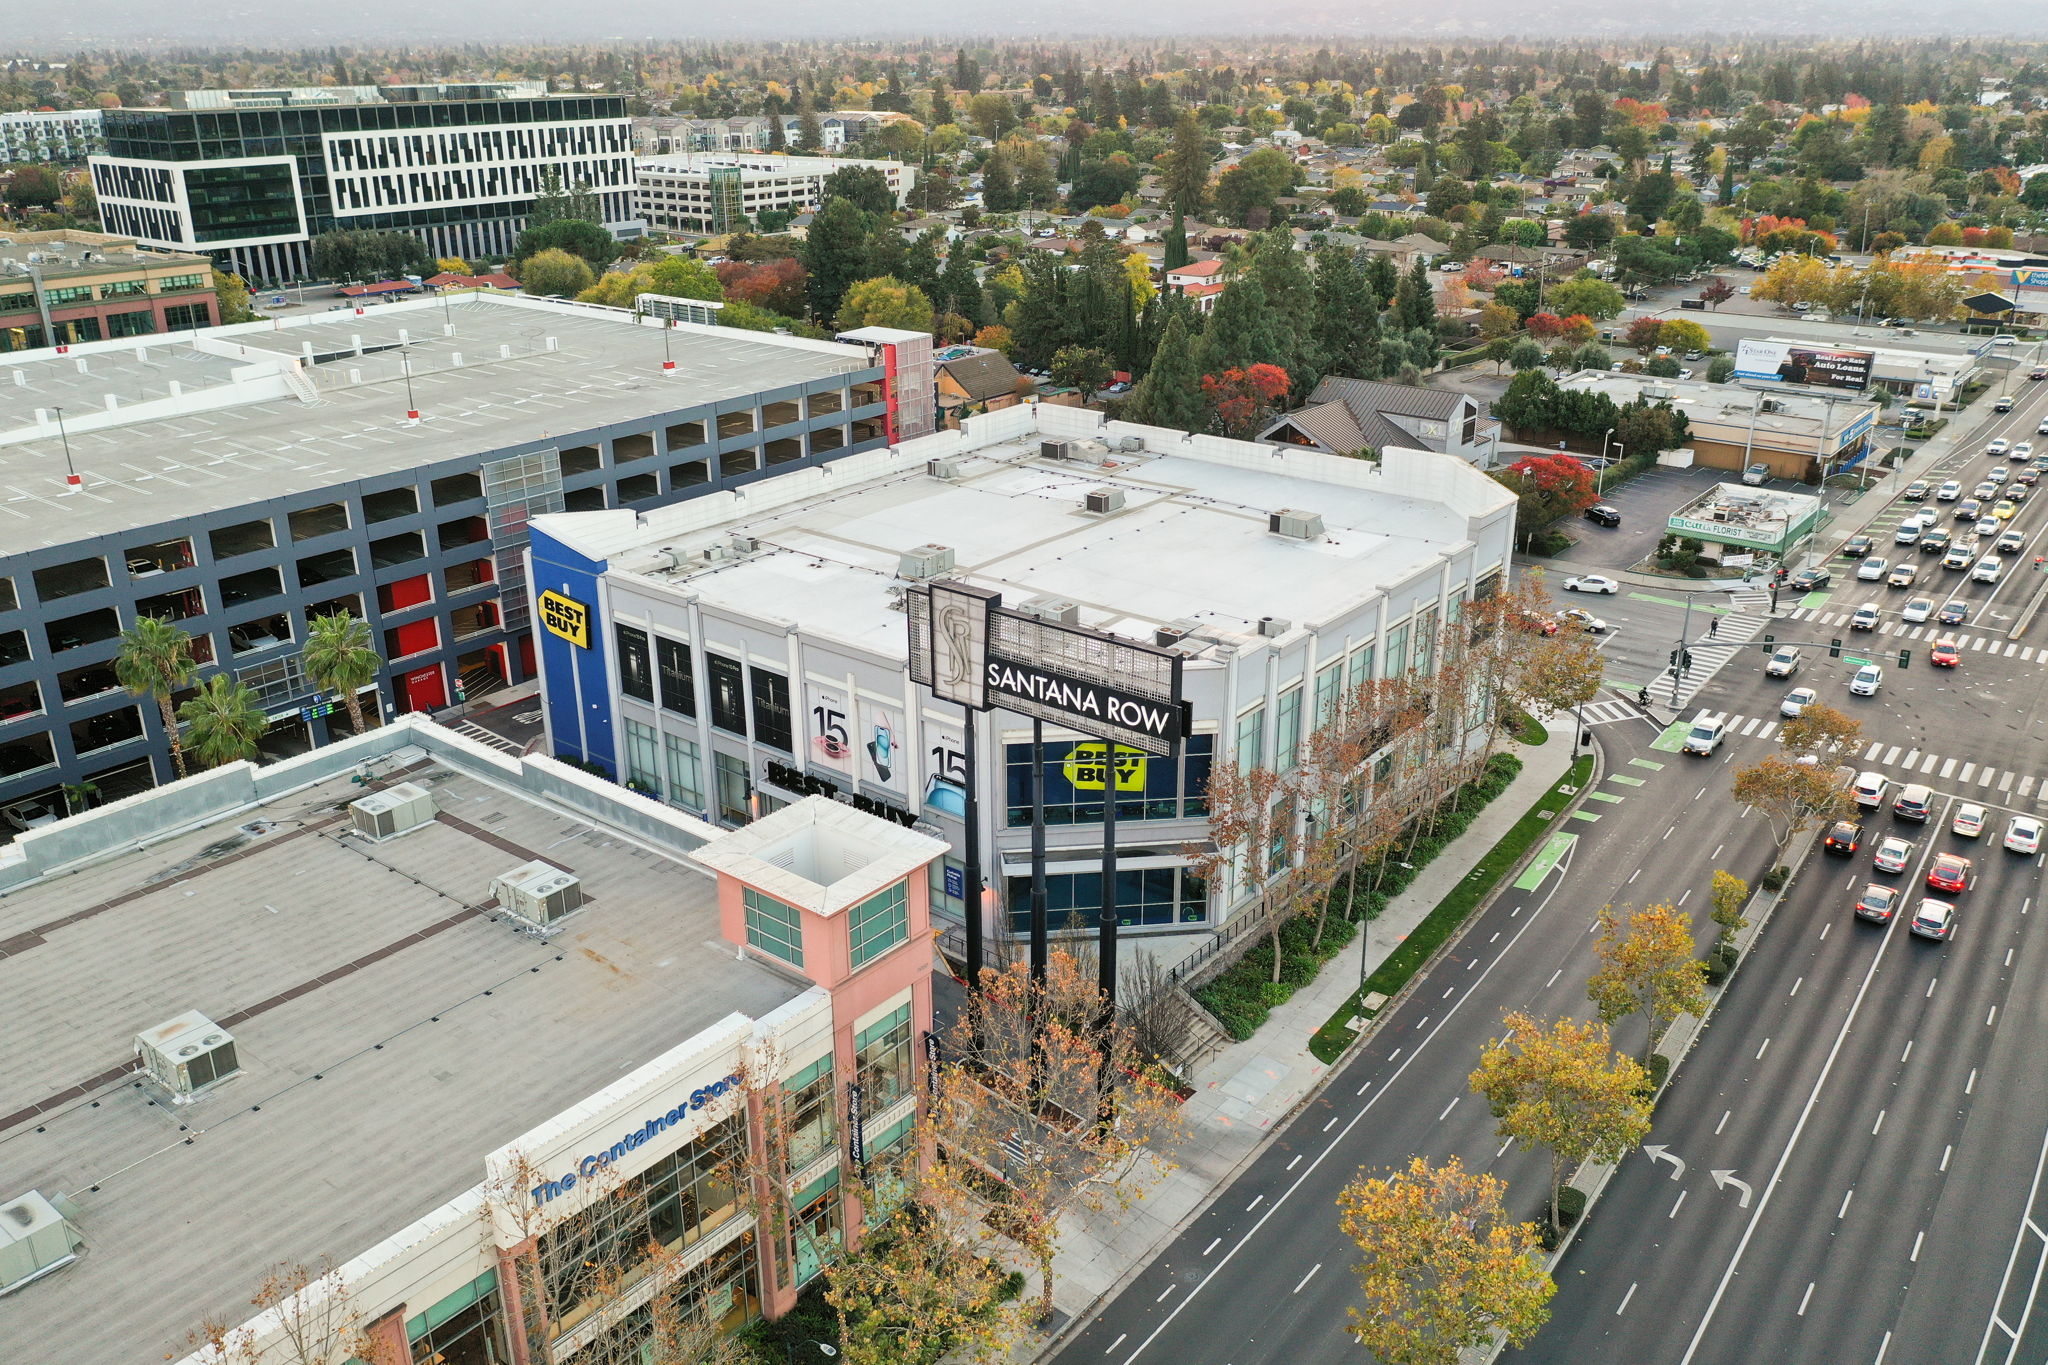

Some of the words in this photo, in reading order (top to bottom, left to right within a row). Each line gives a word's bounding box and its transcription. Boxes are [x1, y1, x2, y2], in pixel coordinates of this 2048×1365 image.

[1814, 361, 1836, 370] Auto
[1836, 364, 1867, 373] Loans.
[1831, 373, 1845, 381] For
[1845, 375, 1864, 383] Real.
[1713, 525, 1743, 537] FLORIST
[544, 596, 583, 624] BEST
[546, 611, 580, 637] BUY
[662, 664, 693, 683] Titanium
[756, 696, 790, 717] Titanium
[825, 695, 838, 705] iPhone
[988, 663, 1100, 716] SANTANA
[1107, 696, 1170, 735] ROW
[813, 705, 848, 747] 15
[945, 735, 960, 745] iPhone
[932, 746, 965, 782] 15
[1075, 750, 1146, 767] BEST
[768, 761, 838, 799] BEST
[531, 1173, 577, 1207] The
[579, 1101, 688, 1178] Container
